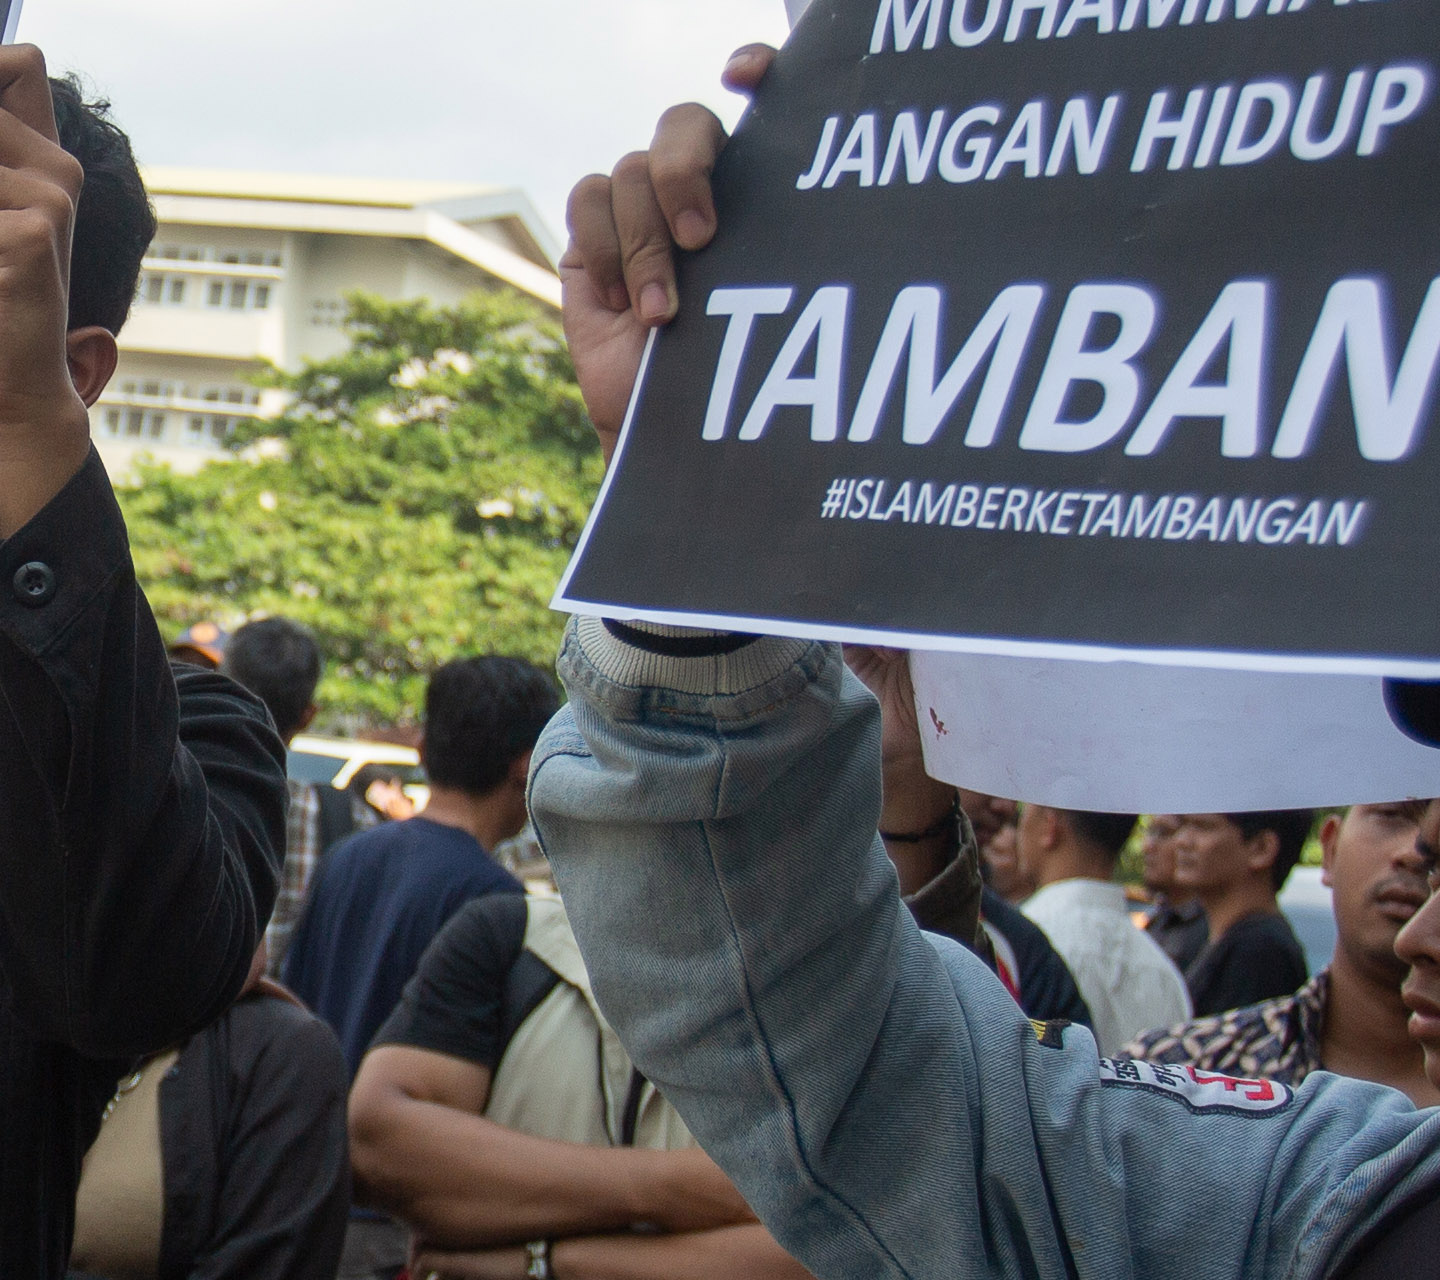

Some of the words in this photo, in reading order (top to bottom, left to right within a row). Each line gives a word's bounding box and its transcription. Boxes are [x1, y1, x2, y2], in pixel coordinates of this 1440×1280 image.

[797, 96, 1118, 189] JANGAN
[1131, 67, 1426, 171] HIDUP
[822, 479, 1364, 544] #ISLAMBERKETAMBANGAN
